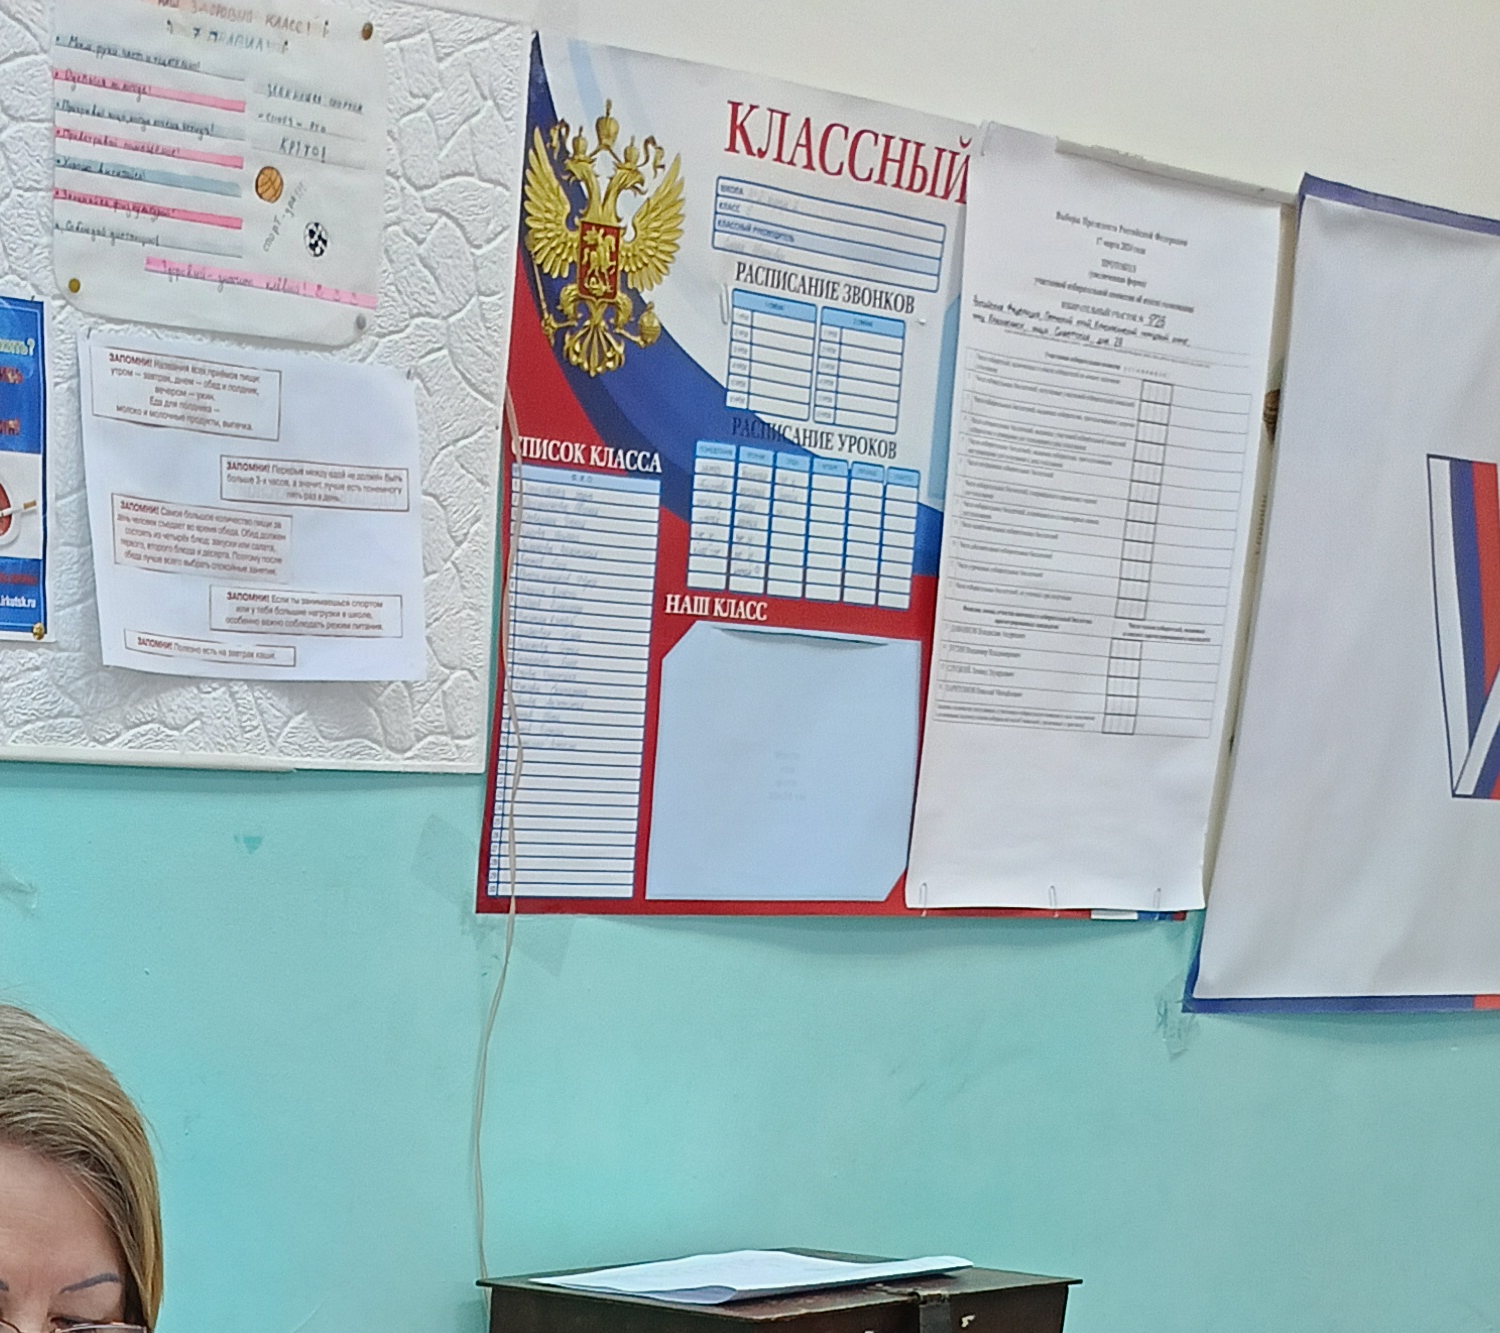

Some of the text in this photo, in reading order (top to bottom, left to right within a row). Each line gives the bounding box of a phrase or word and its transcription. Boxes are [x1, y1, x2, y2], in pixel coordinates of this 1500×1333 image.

[724, 100, 973, 205] КЛАССНЫЙ
[733, 259, 916, 316] РАСПИСАНИЕ ЗВОНКОВ
[510, 434, 662, 474] СПИСОК КЛАССА
[731, 416, 898, 459] РАСПИСАНИЕ УРОКОВ
[664, 593, 767, 621] НАШ КЛАСС
